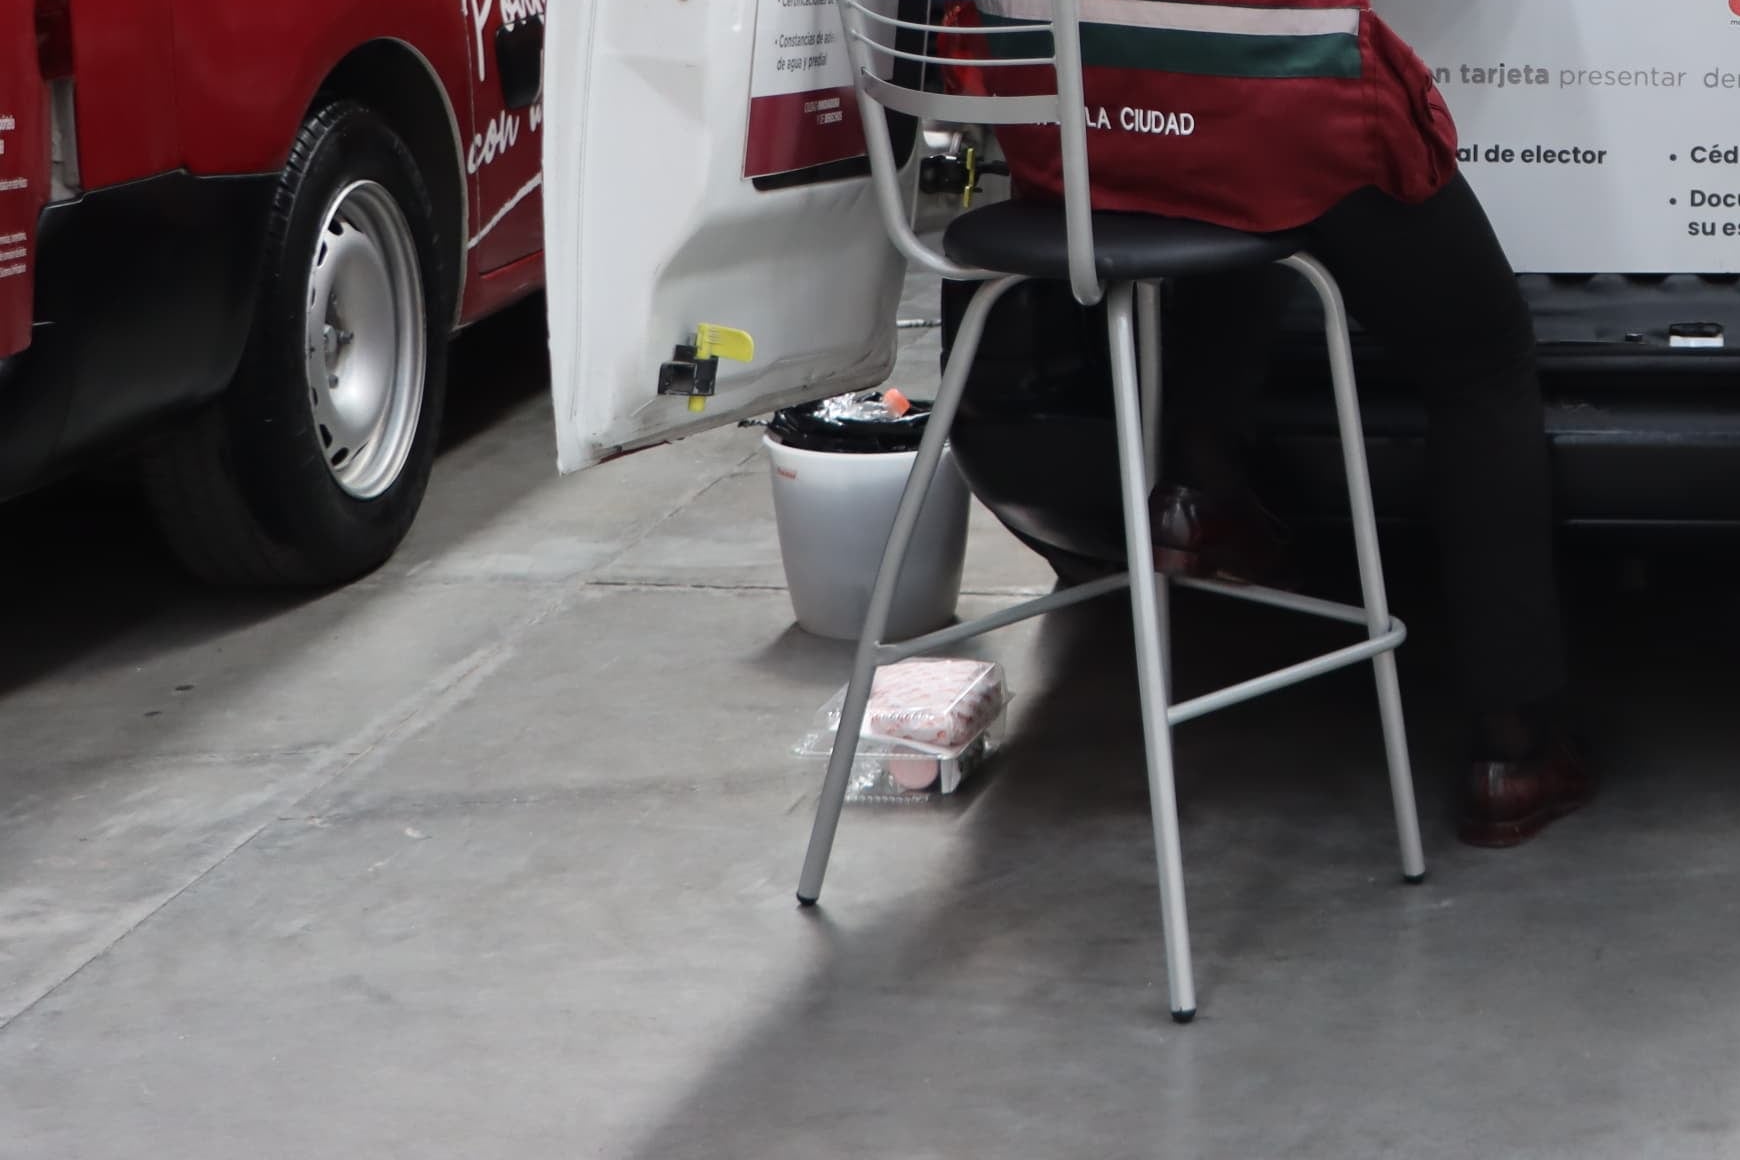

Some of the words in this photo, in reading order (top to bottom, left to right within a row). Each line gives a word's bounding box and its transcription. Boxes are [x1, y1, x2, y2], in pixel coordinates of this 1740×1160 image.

[1460, 62, 1550, 88] tarjeta
[1559, 67, 1688, 89] presentar
[1085, 106, 1112, 130] LA
[1120, 106, 1195, 136] CIUDAD
[1485, 144, 1515, 163] de
[1521, 145, 1608, 165] elector
[1688, 221, 1716, 237] su
